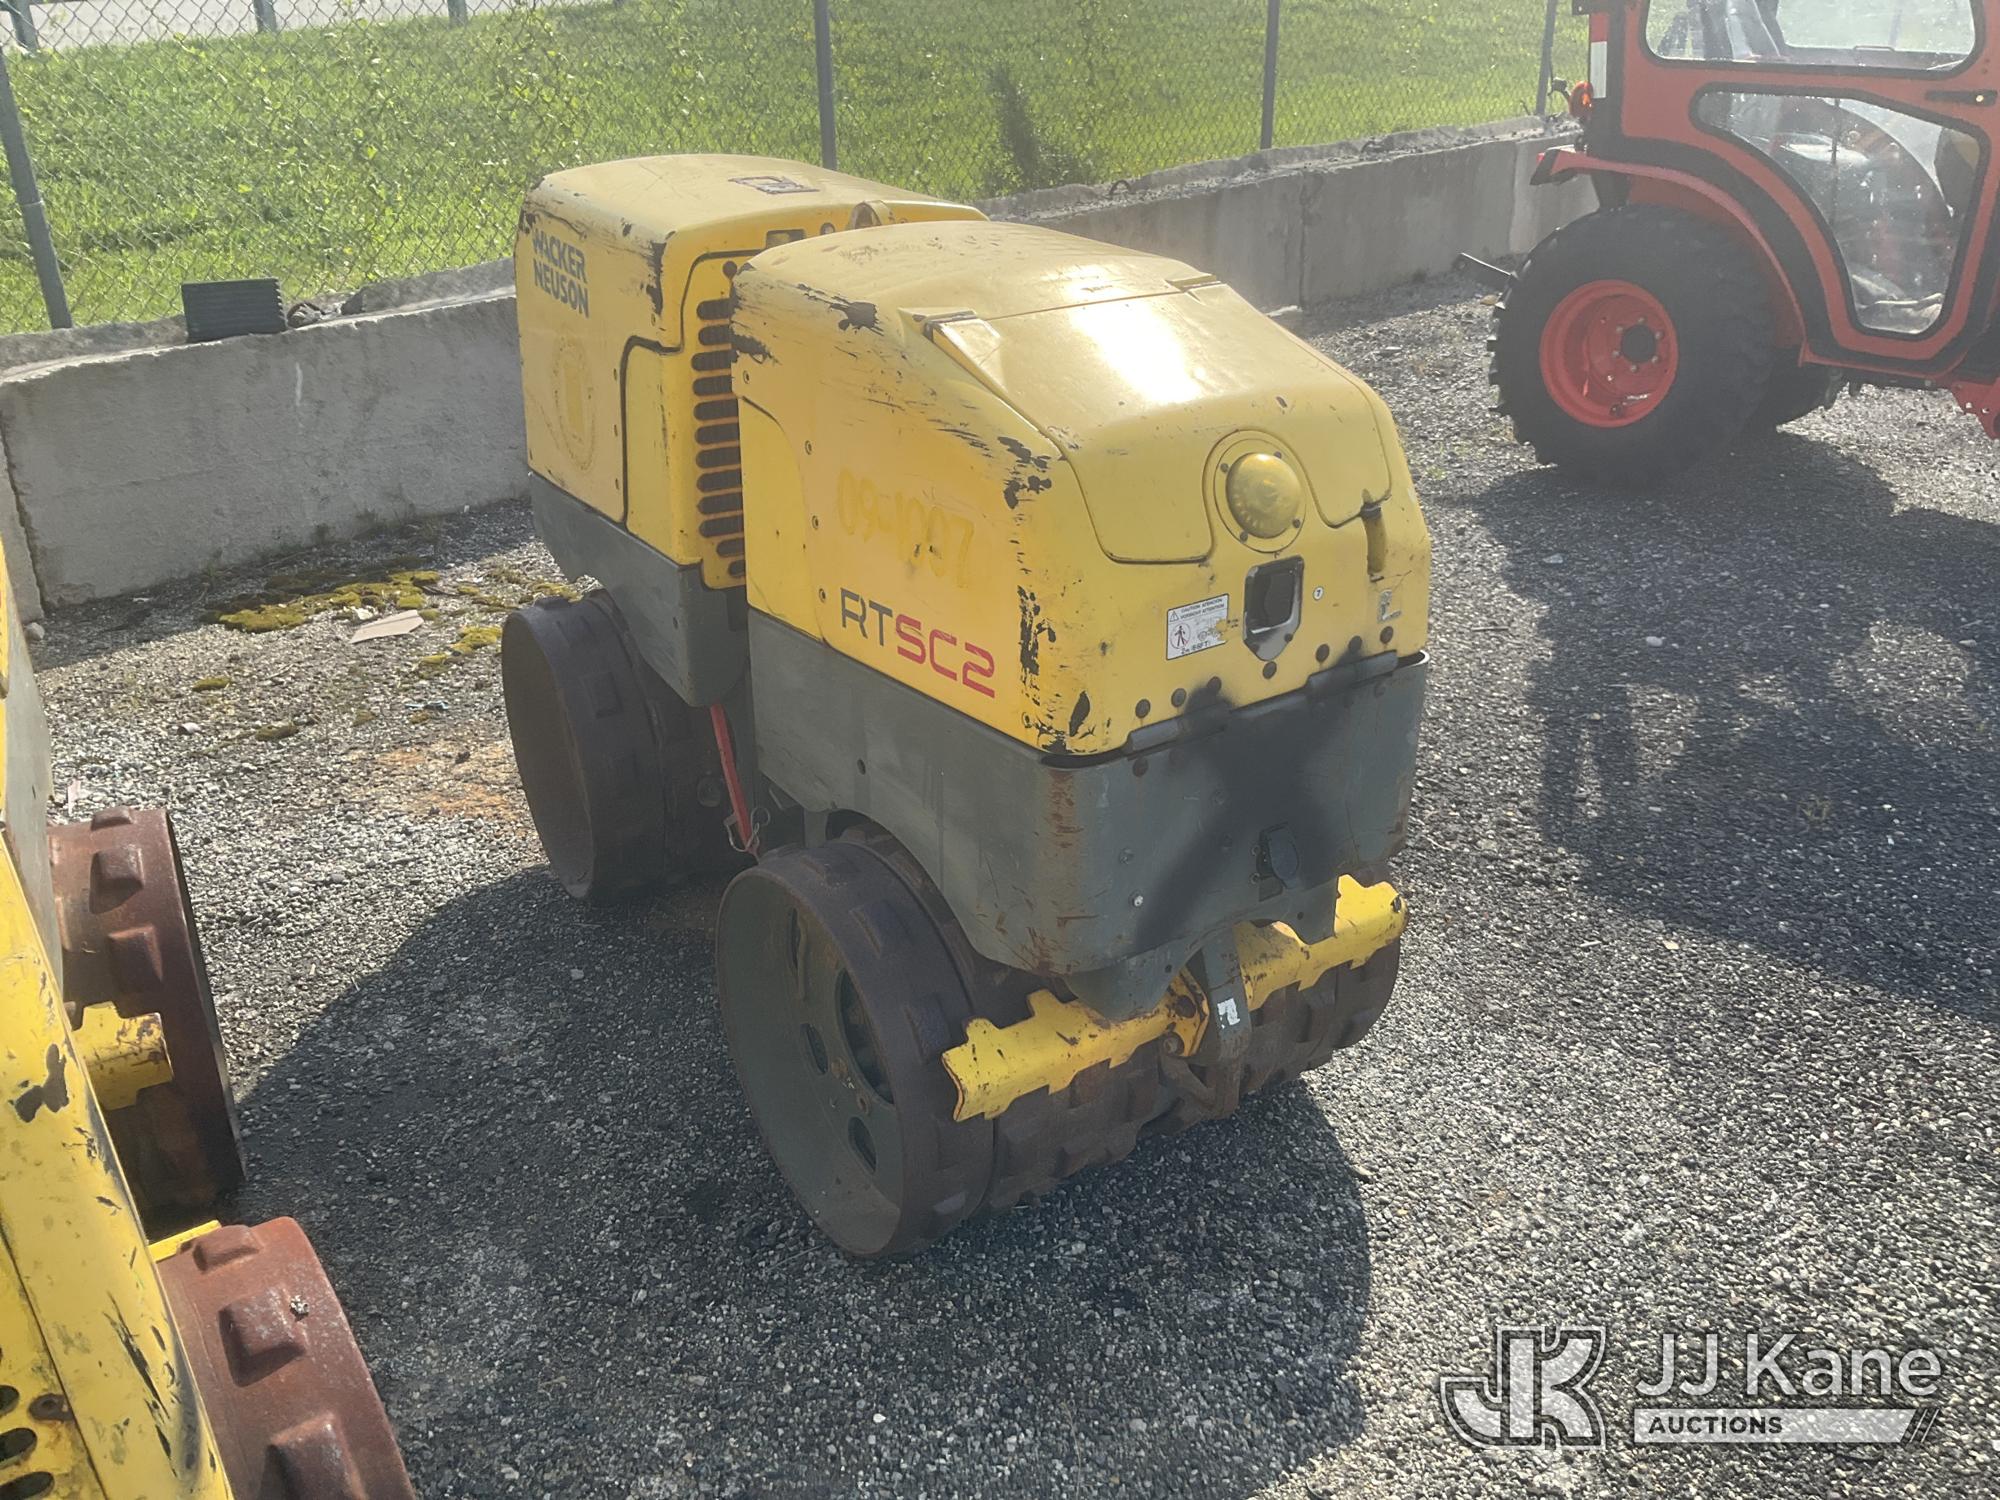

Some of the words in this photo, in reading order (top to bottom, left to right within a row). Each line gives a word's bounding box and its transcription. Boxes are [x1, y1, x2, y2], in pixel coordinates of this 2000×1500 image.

[532, 231, 588, 284] WACKER
[533, 258, 589, 318] NEUSON
[840, 587, 995, 698] RTSC2
